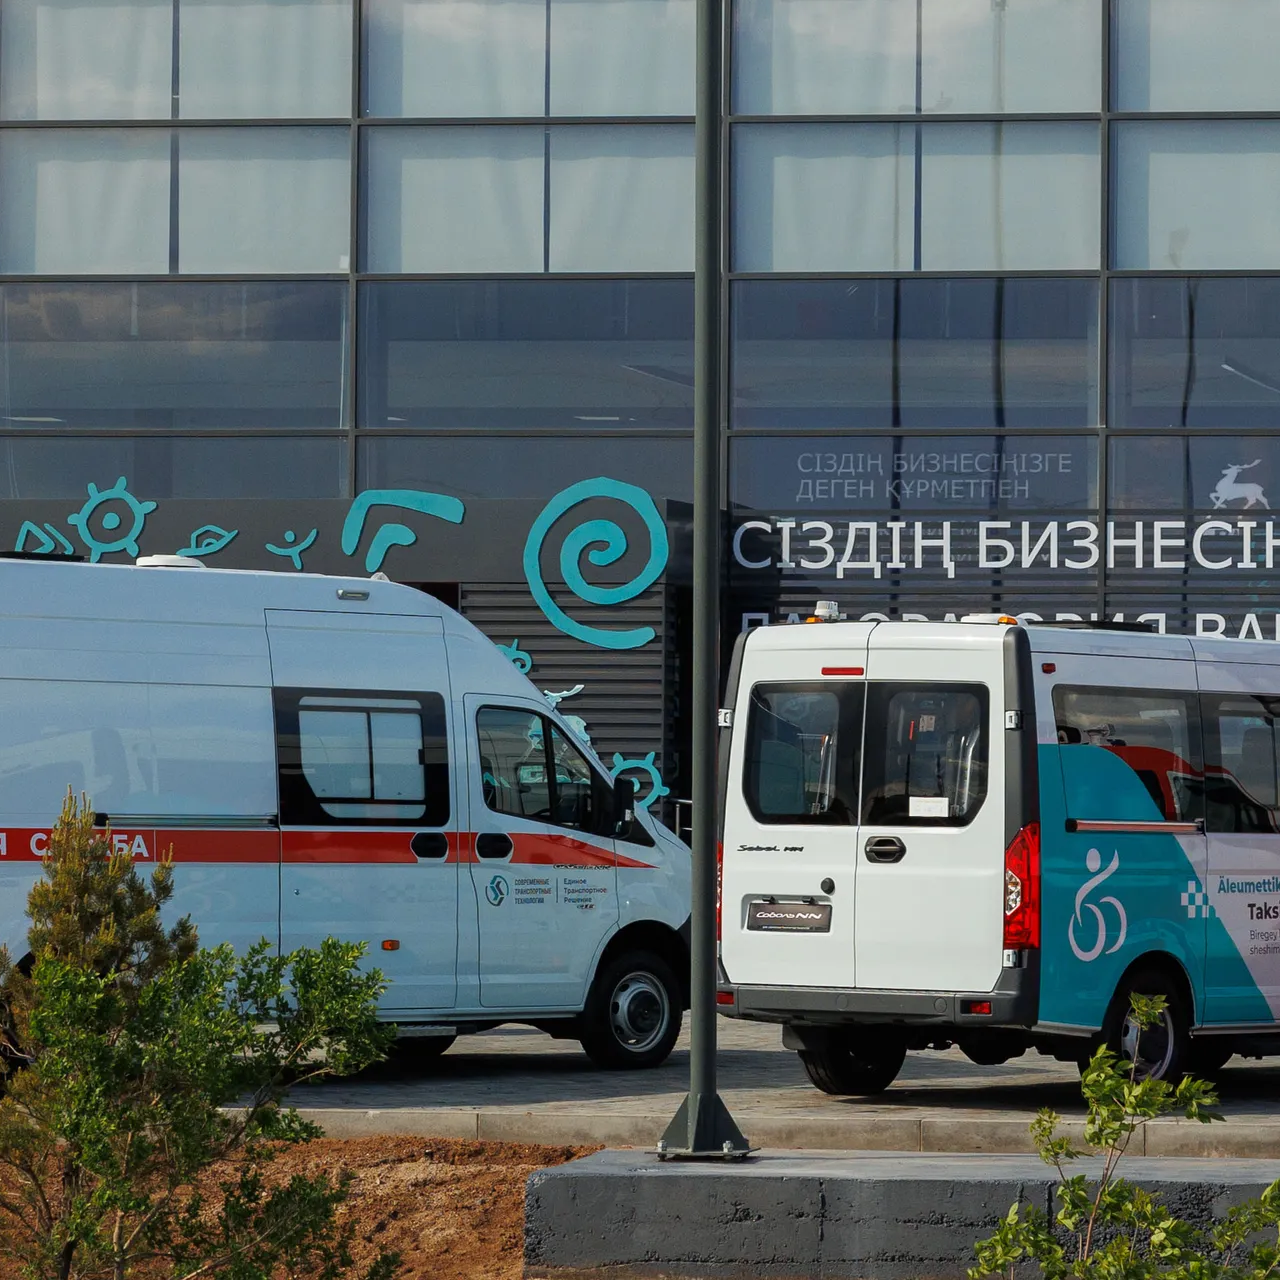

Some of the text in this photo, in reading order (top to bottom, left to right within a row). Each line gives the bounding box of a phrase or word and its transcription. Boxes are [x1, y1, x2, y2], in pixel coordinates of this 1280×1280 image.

[796, 453, 883, 476] СІЗДІҢ
[796, 479, 875, 502] ДЕГЕН
[732, 521, 956, 579] СІЗДІҢ
